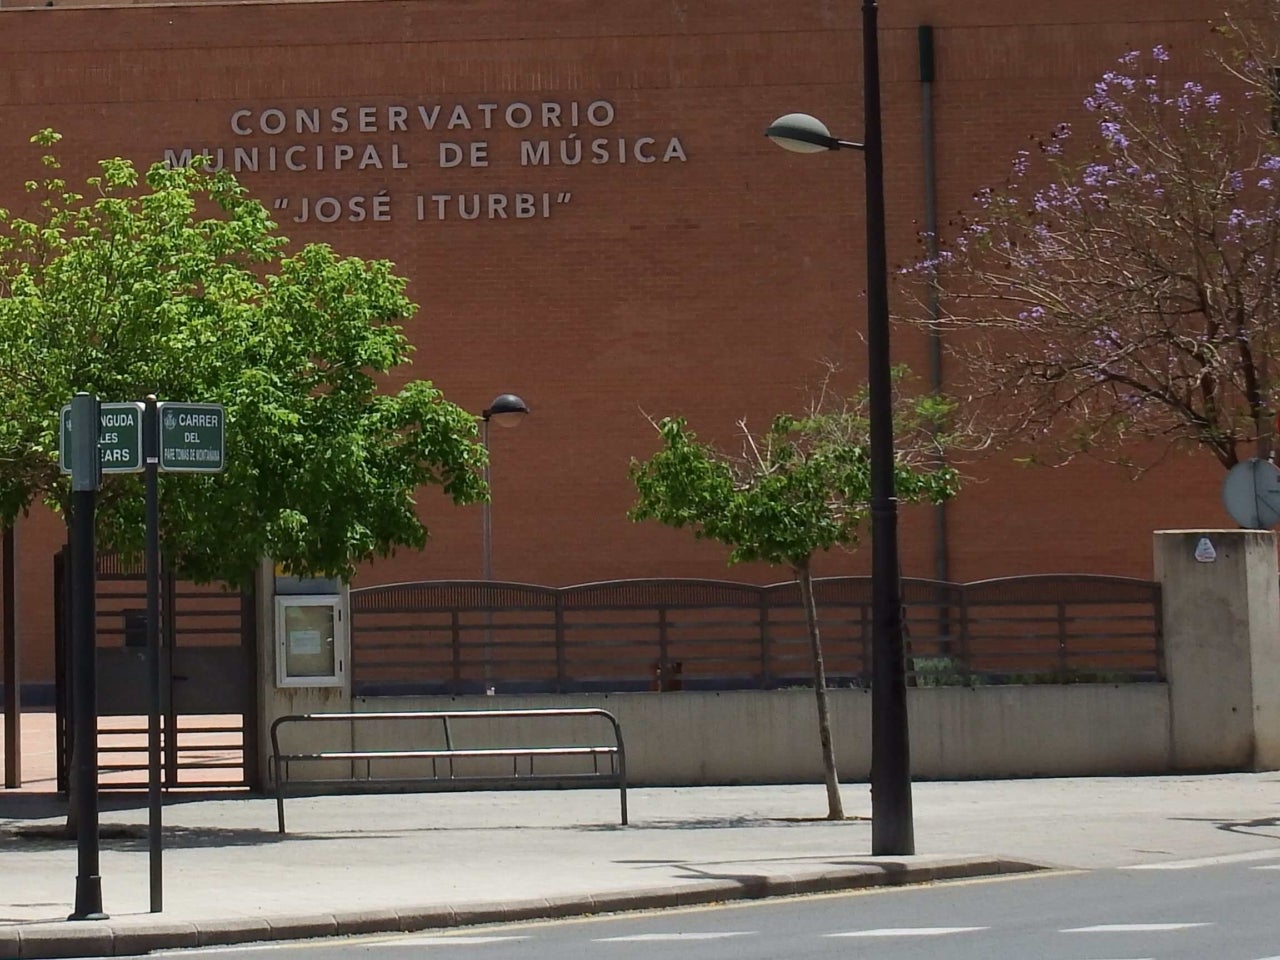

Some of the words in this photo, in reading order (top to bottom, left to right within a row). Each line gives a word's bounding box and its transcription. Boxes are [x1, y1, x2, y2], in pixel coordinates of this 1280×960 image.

[230, 100, 616, 136] CONSERVATORIO
[164, 143, 409, 173] MUNICIPAL
[439, 141, 489, 168] DE
[520, 133, 688, 167] MÚSICA
[101, 414, 134, 427] NGUDA
[179, 414, 218, 428] CARRER
[184, 432, 200, 443] DEL
